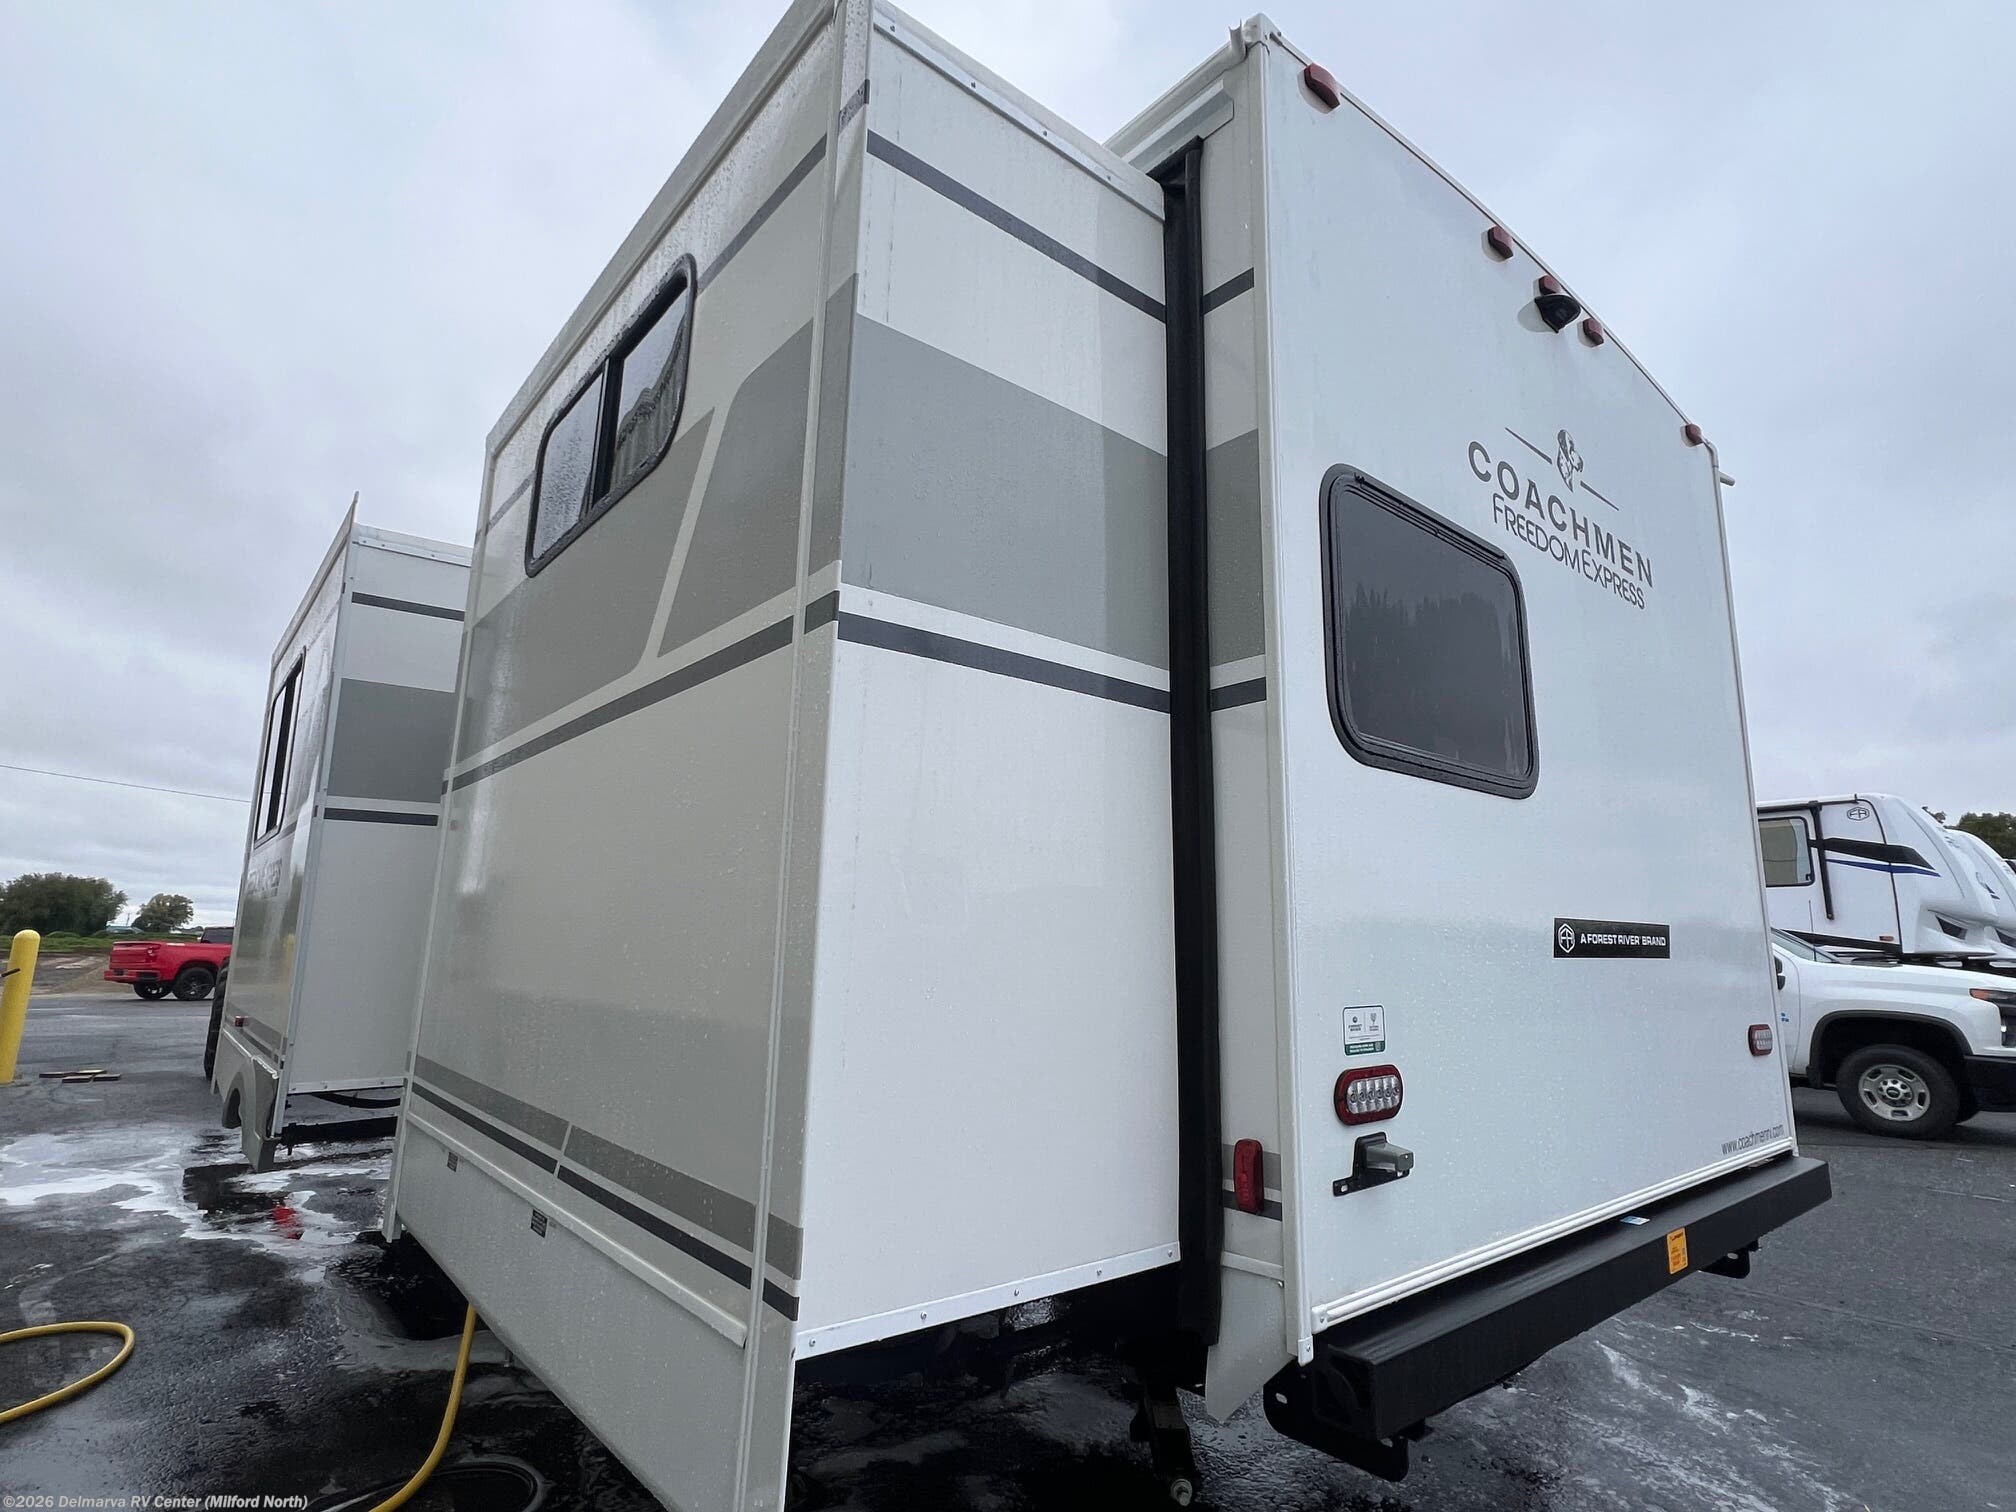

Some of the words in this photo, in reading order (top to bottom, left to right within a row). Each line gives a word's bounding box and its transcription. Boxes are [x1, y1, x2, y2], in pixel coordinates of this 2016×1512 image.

[1468, 441, 1653, 588] COACHMEN
[1580, 933, 1587, 944] A
[1587, 933, 1618, 945] FOREST
[1618, 934, 1640, 946] RIVER
[1641, 935, 1666, 946] BRAND
